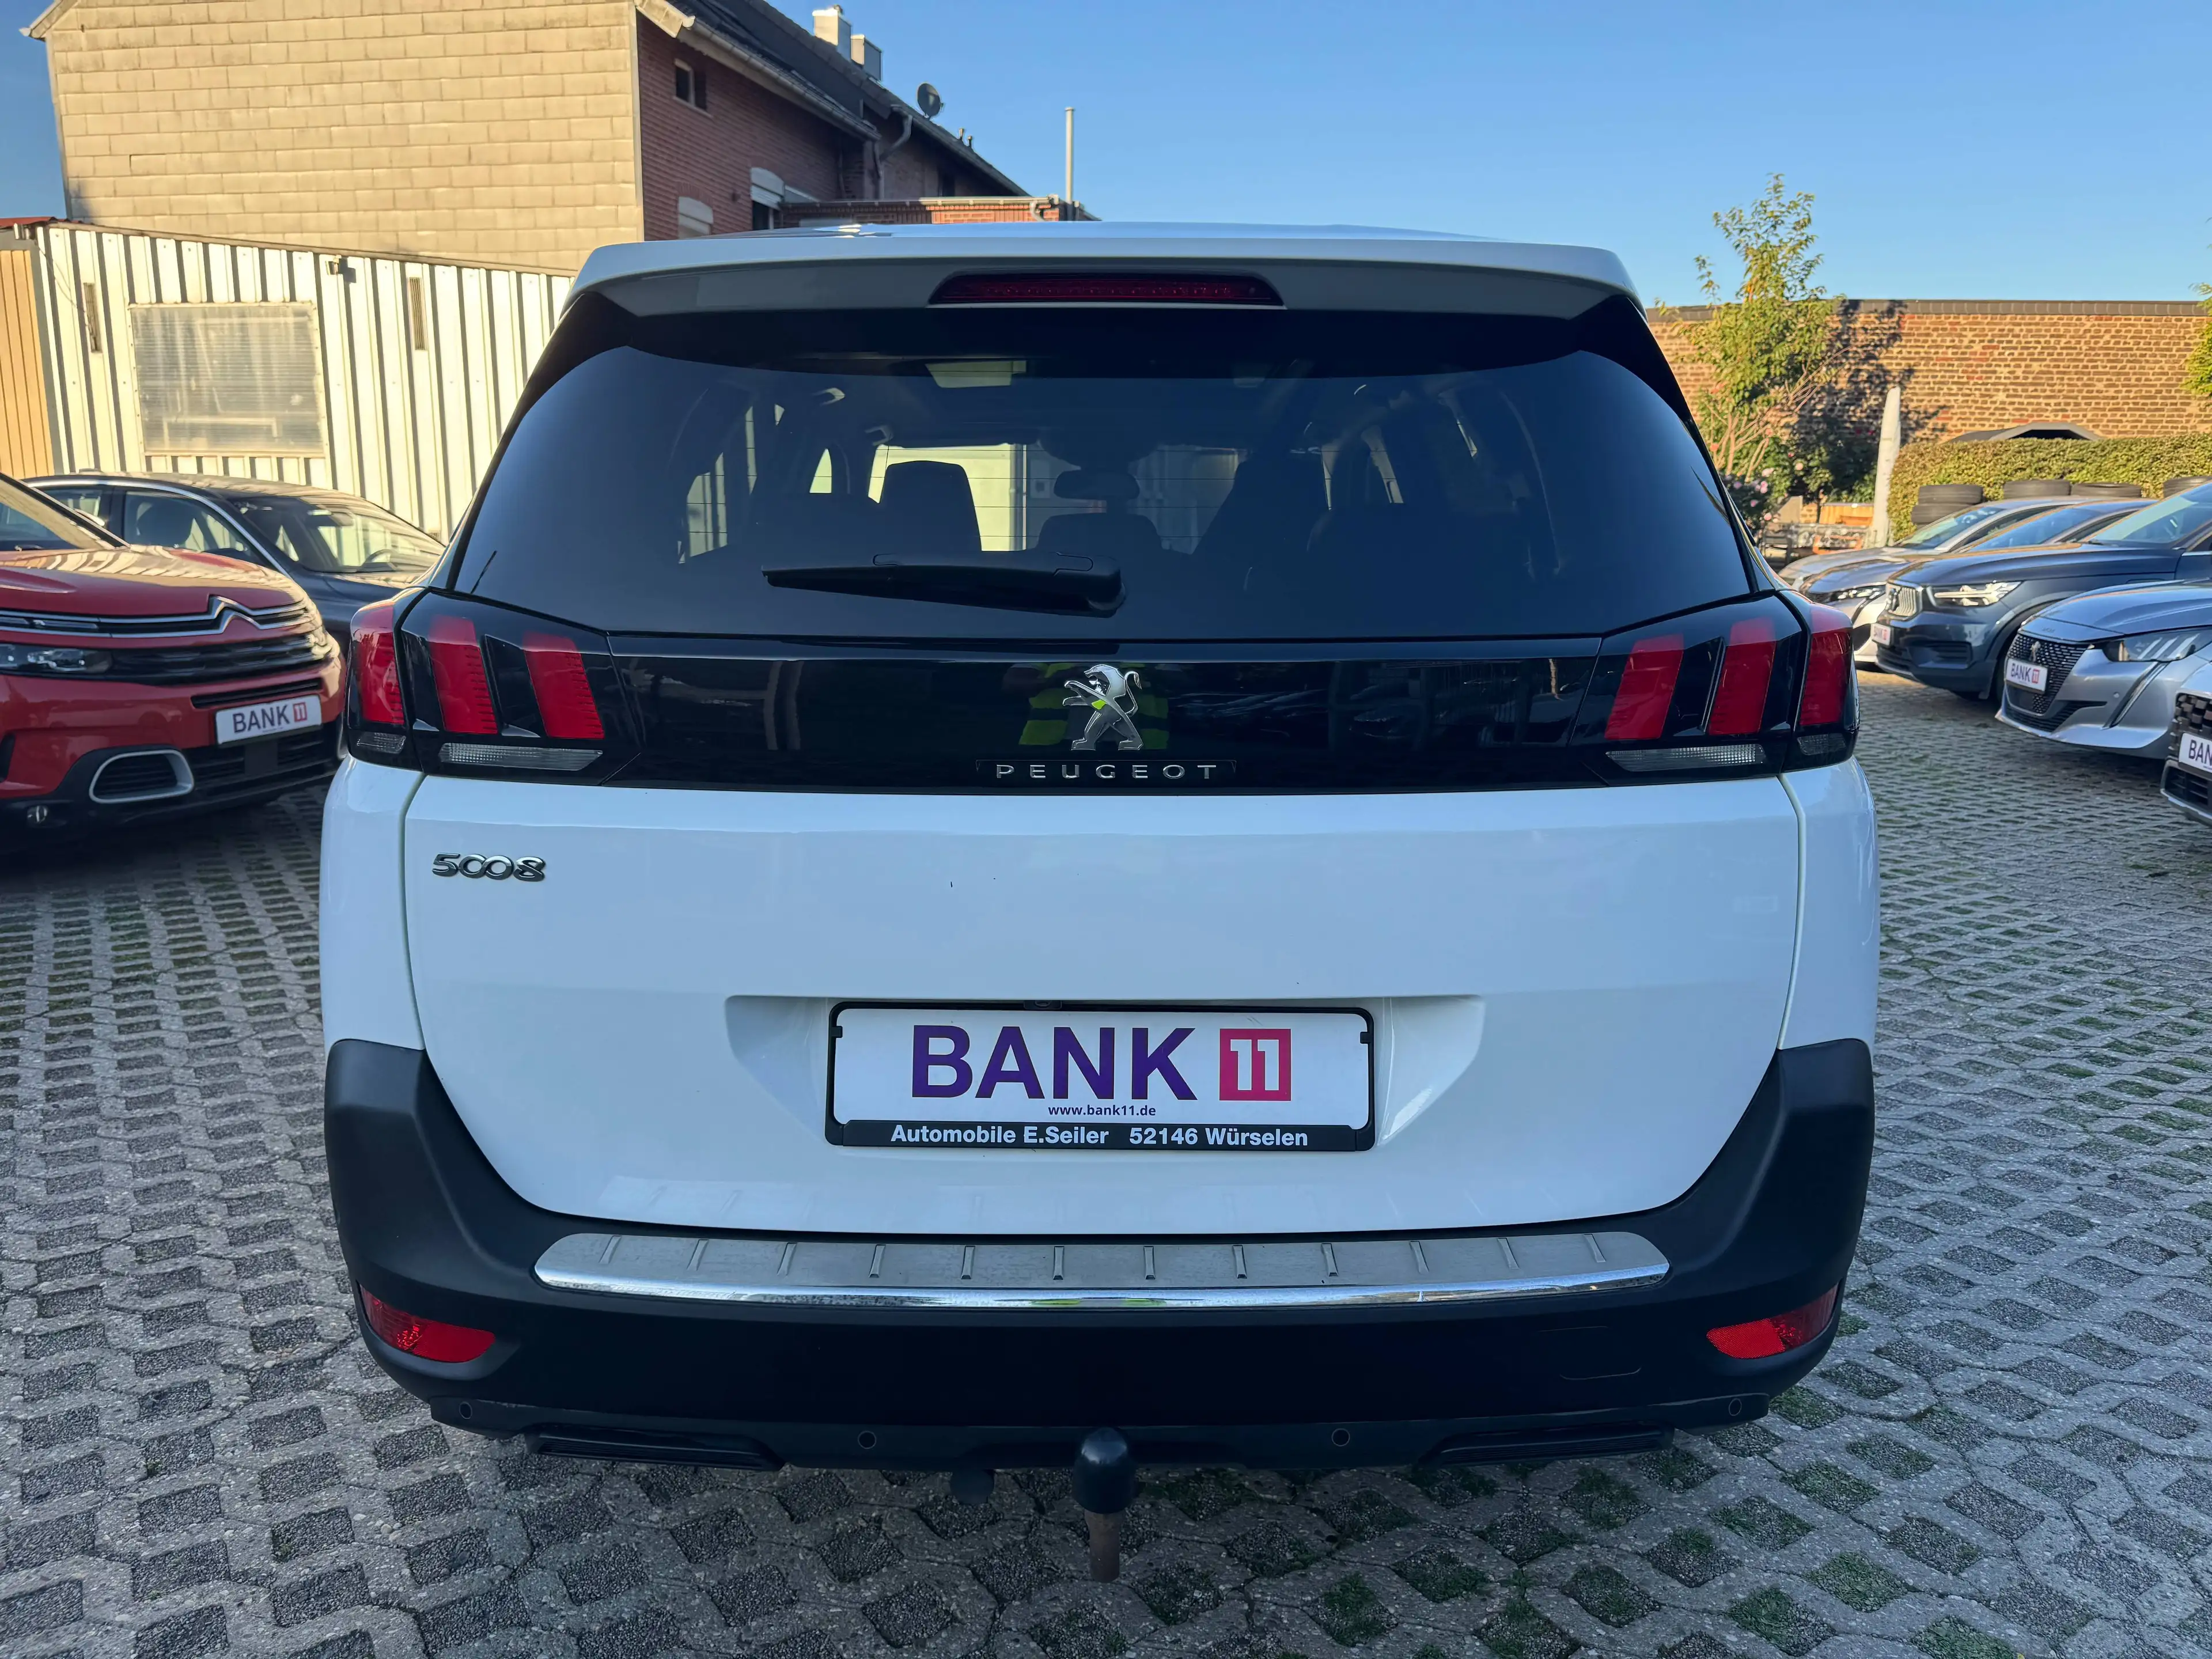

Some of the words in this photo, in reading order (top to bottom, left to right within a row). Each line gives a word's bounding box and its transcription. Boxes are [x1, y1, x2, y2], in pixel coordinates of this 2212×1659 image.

[2011, 663, 2031, 682] BANK
[233, 704, 290, 733] BANK
[996, 764, 1217, 779] PEUGEOT
[432, 853, 546, 882] 5008
[912, 1025, 1198, 1101] BANK
[1047, 1104, 1156, 1117] www.bank11.de
[891, 1124, 1016, 1143] Automobile
[1024, 1126, 1109, 1144] E.Seiler
[1129, 1127, 1198, 1145] 52146
[1205, 1128, 1308, 1146] Würselen
